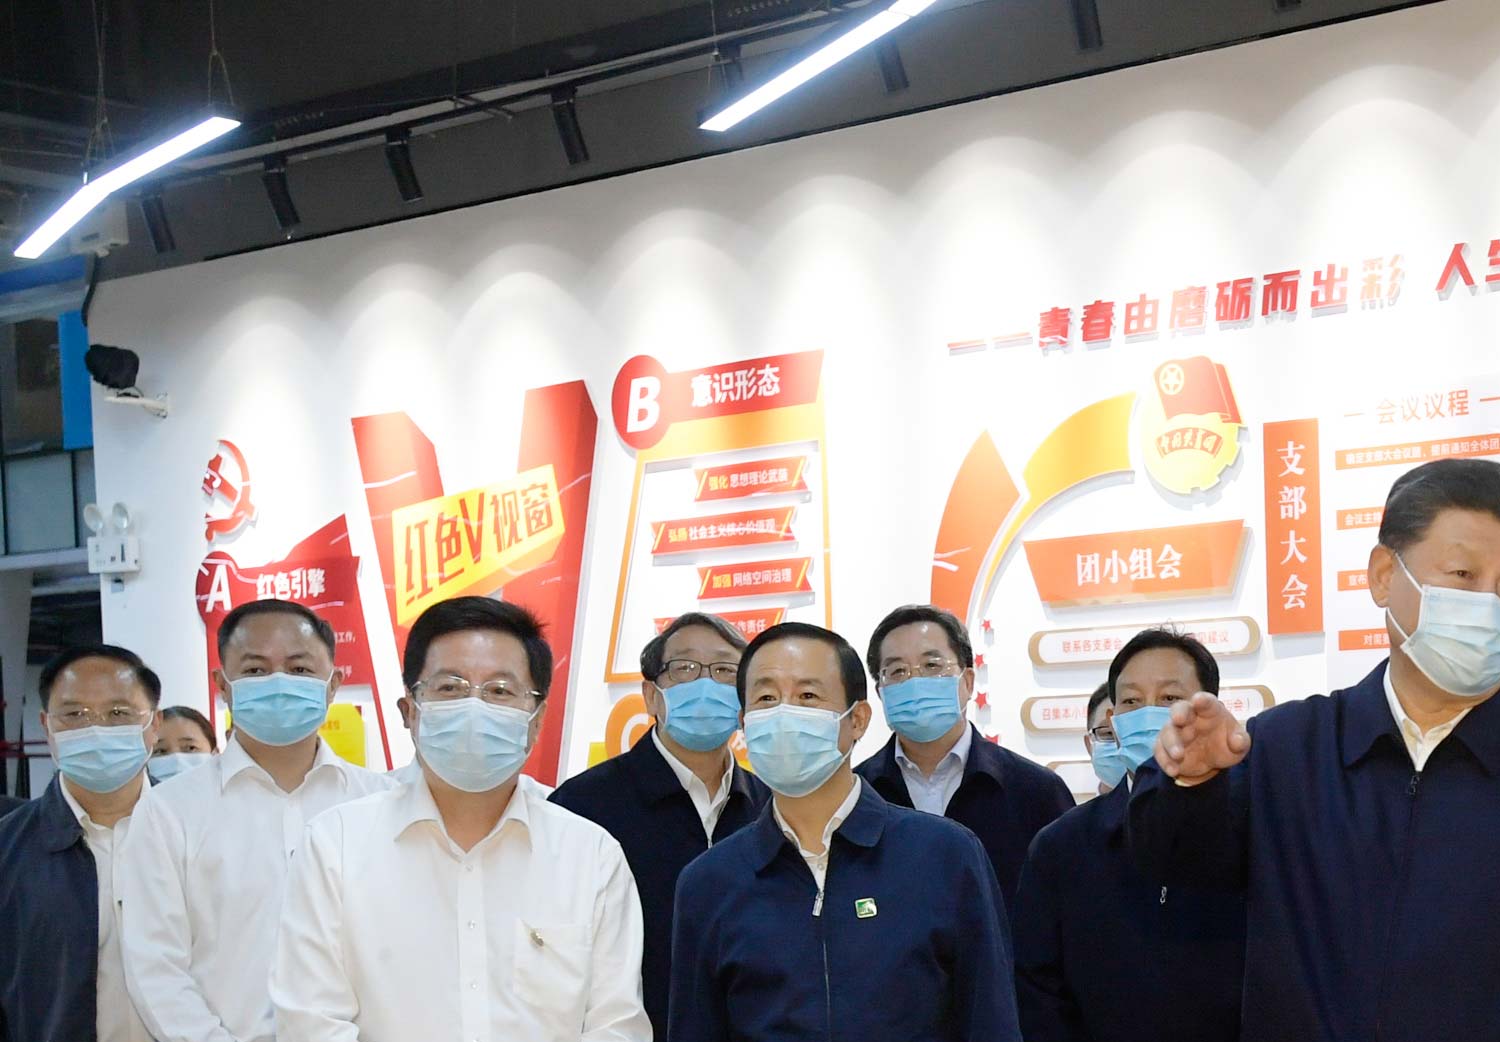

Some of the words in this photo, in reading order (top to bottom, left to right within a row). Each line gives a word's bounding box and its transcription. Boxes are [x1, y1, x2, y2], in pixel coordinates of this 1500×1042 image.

[626, 376, 661, 433] B
[690, 363, 780, 408] 意识形态
[1376, 389, 1470, 425] 会议议程
[405, 482, 553, 606] 红色V视窗
[689, 518, 776, 541] 社会主义核心价值观
[1276, 441, 1308, 610] 支部大会
[256, 567, 326, 600] 红色引擎
[712, 574, 732, 588] 加强
[733, 568, 792, 586] 网络空间治理
[1075, 543, 1183, 587] 团小组会
[206, 564, 232, 613] A
